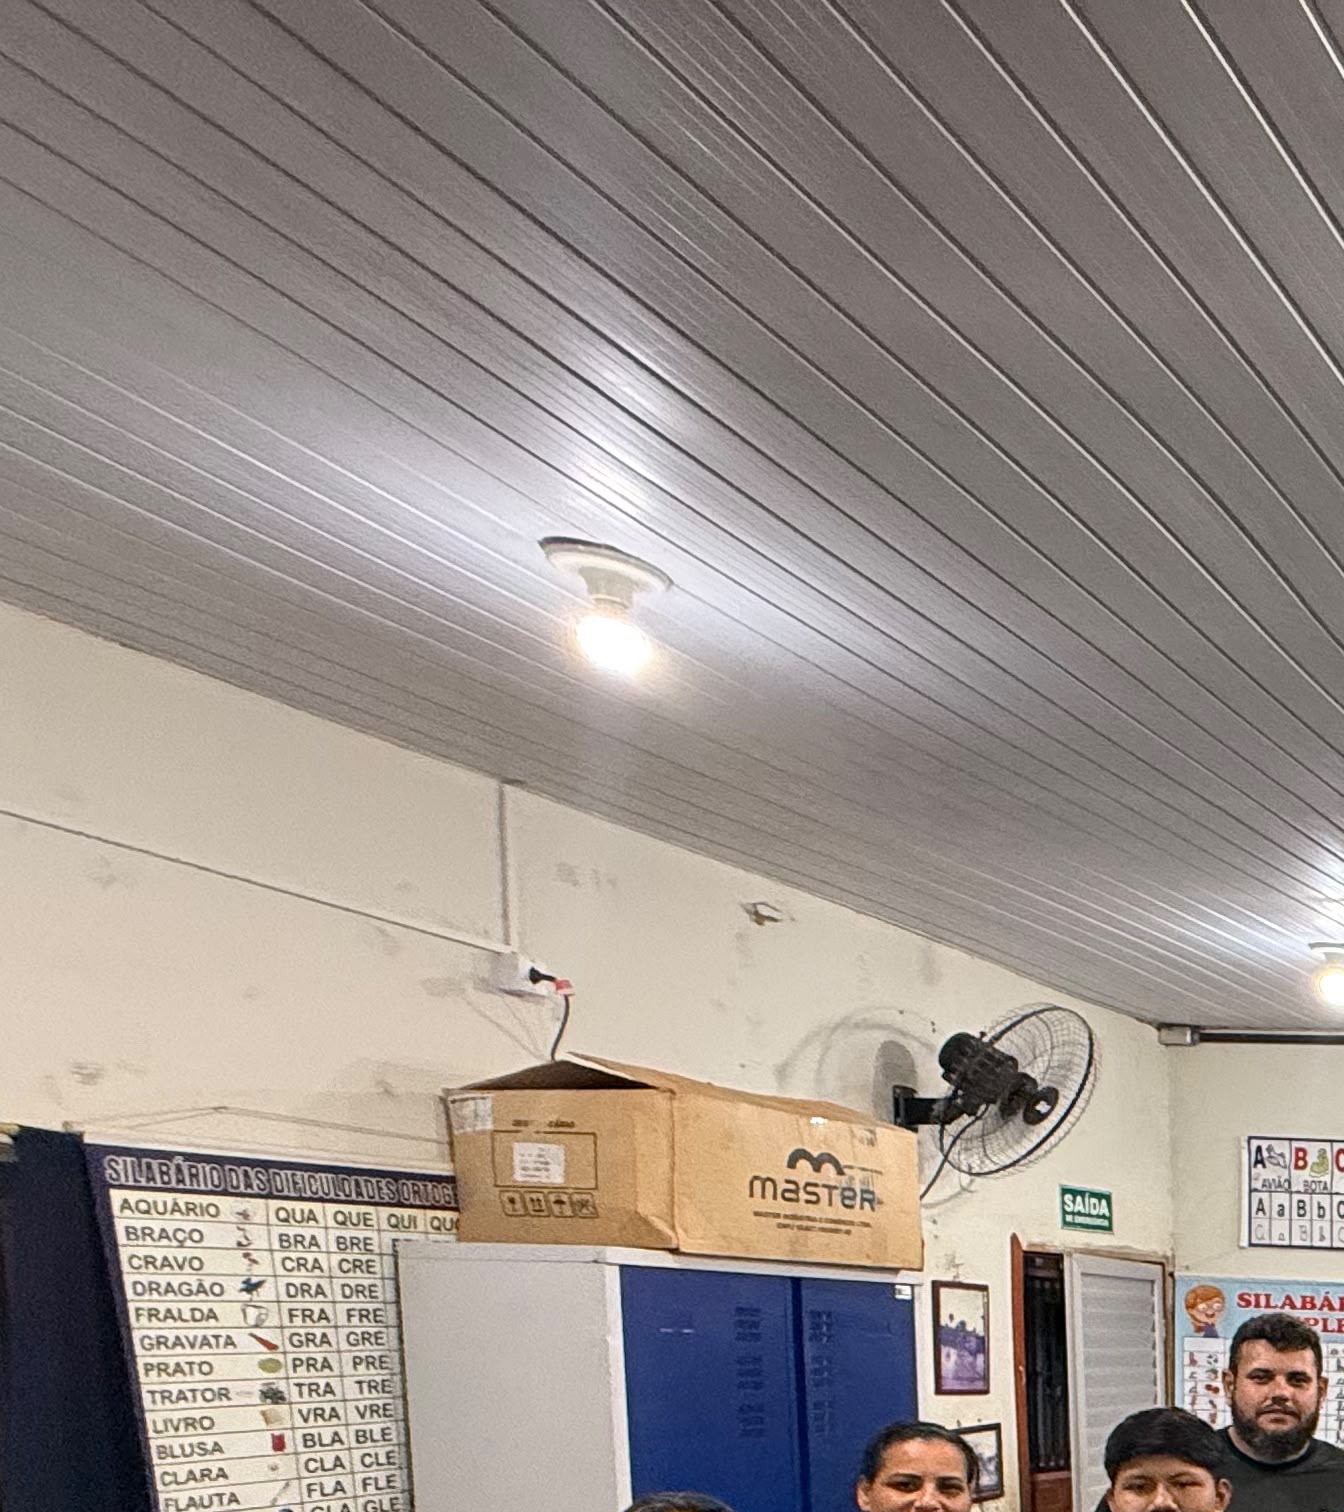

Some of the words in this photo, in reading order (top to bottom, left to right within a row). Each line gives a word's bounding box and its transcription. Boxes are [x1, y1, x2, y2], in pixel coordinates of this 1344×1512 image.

[1253, 1145, 1266, 1168] A
[1294, 1147, 1308, 1170] B
[105, 1157, 223, 1189] SILABÁRIO
[227, 1168, 270, 1194] DAS
[272, 1174, 399, 1202] DIFICULDADES
[1304, 1180, 1329, 1192] BOTA
[119, 1198, 221, 1218] AQUÁRIO
[275, 1208, 320, 1225] QUA
[333, 1210, 374, 1228] QUE
[387, 1213, 418, 1231] QUI
[1064, 1192, 1110, 1217] SAÍDA
[125, 1225, 204, 1246] BRAÇO
[279, 1233, 321, 1250] BRA
[336, 1236, 374, 1252] BRE
[128, 1254, 204, 1271] CRAVO
[282, 1257, 324, 1274] CRA
[338, 1259, 377, 1275] CRE
[132, 1278, 225, 1297] DRAGÃO
[285, 1282, 327, 1299] DRA
[341, 1284, 379, 1300] DRE
[135, 1307, 219, 1323] FRALDA
[288, 1308, 331, 1324] FRA
[346, 1308, 385, 1324] FRE
[139, 1333, 237, 1350] GRAVATA
[289, 1331, 332, 1349] GRA
[346, 1330, 386, 1347] GRE
[143, 1360, 214, 1377] PRATO
[292, 1357, 334, 1374] PRA
[352, 1355, 389, 1371] PRE
[147, 1386, 232, 1407] TRATOR
[296, 1382, 336, 1399] TRA
[355, 1378, 393, 1395] TRE
[152, 1416, 215, 1435] LIVRO
[299, 1407, 341, 1424] VRA
[355, 1402, 394, 1419] VRE
[157, 1441, 224, 1460] BLUSA
[302, 1432, 345, 1449] BLA
[355, 1426, 393, 1445] BLE
[160, 1468, 228, 1487] CLARA
[304, 1455, 347, 1473] CLA
[360, 1449, 398, 1468] CLE
[164, 1491, 241, 1512] FLAUTA
[307, 1480, 347, 1498] FLA
[362, 1474, 398, 1492] FLE
